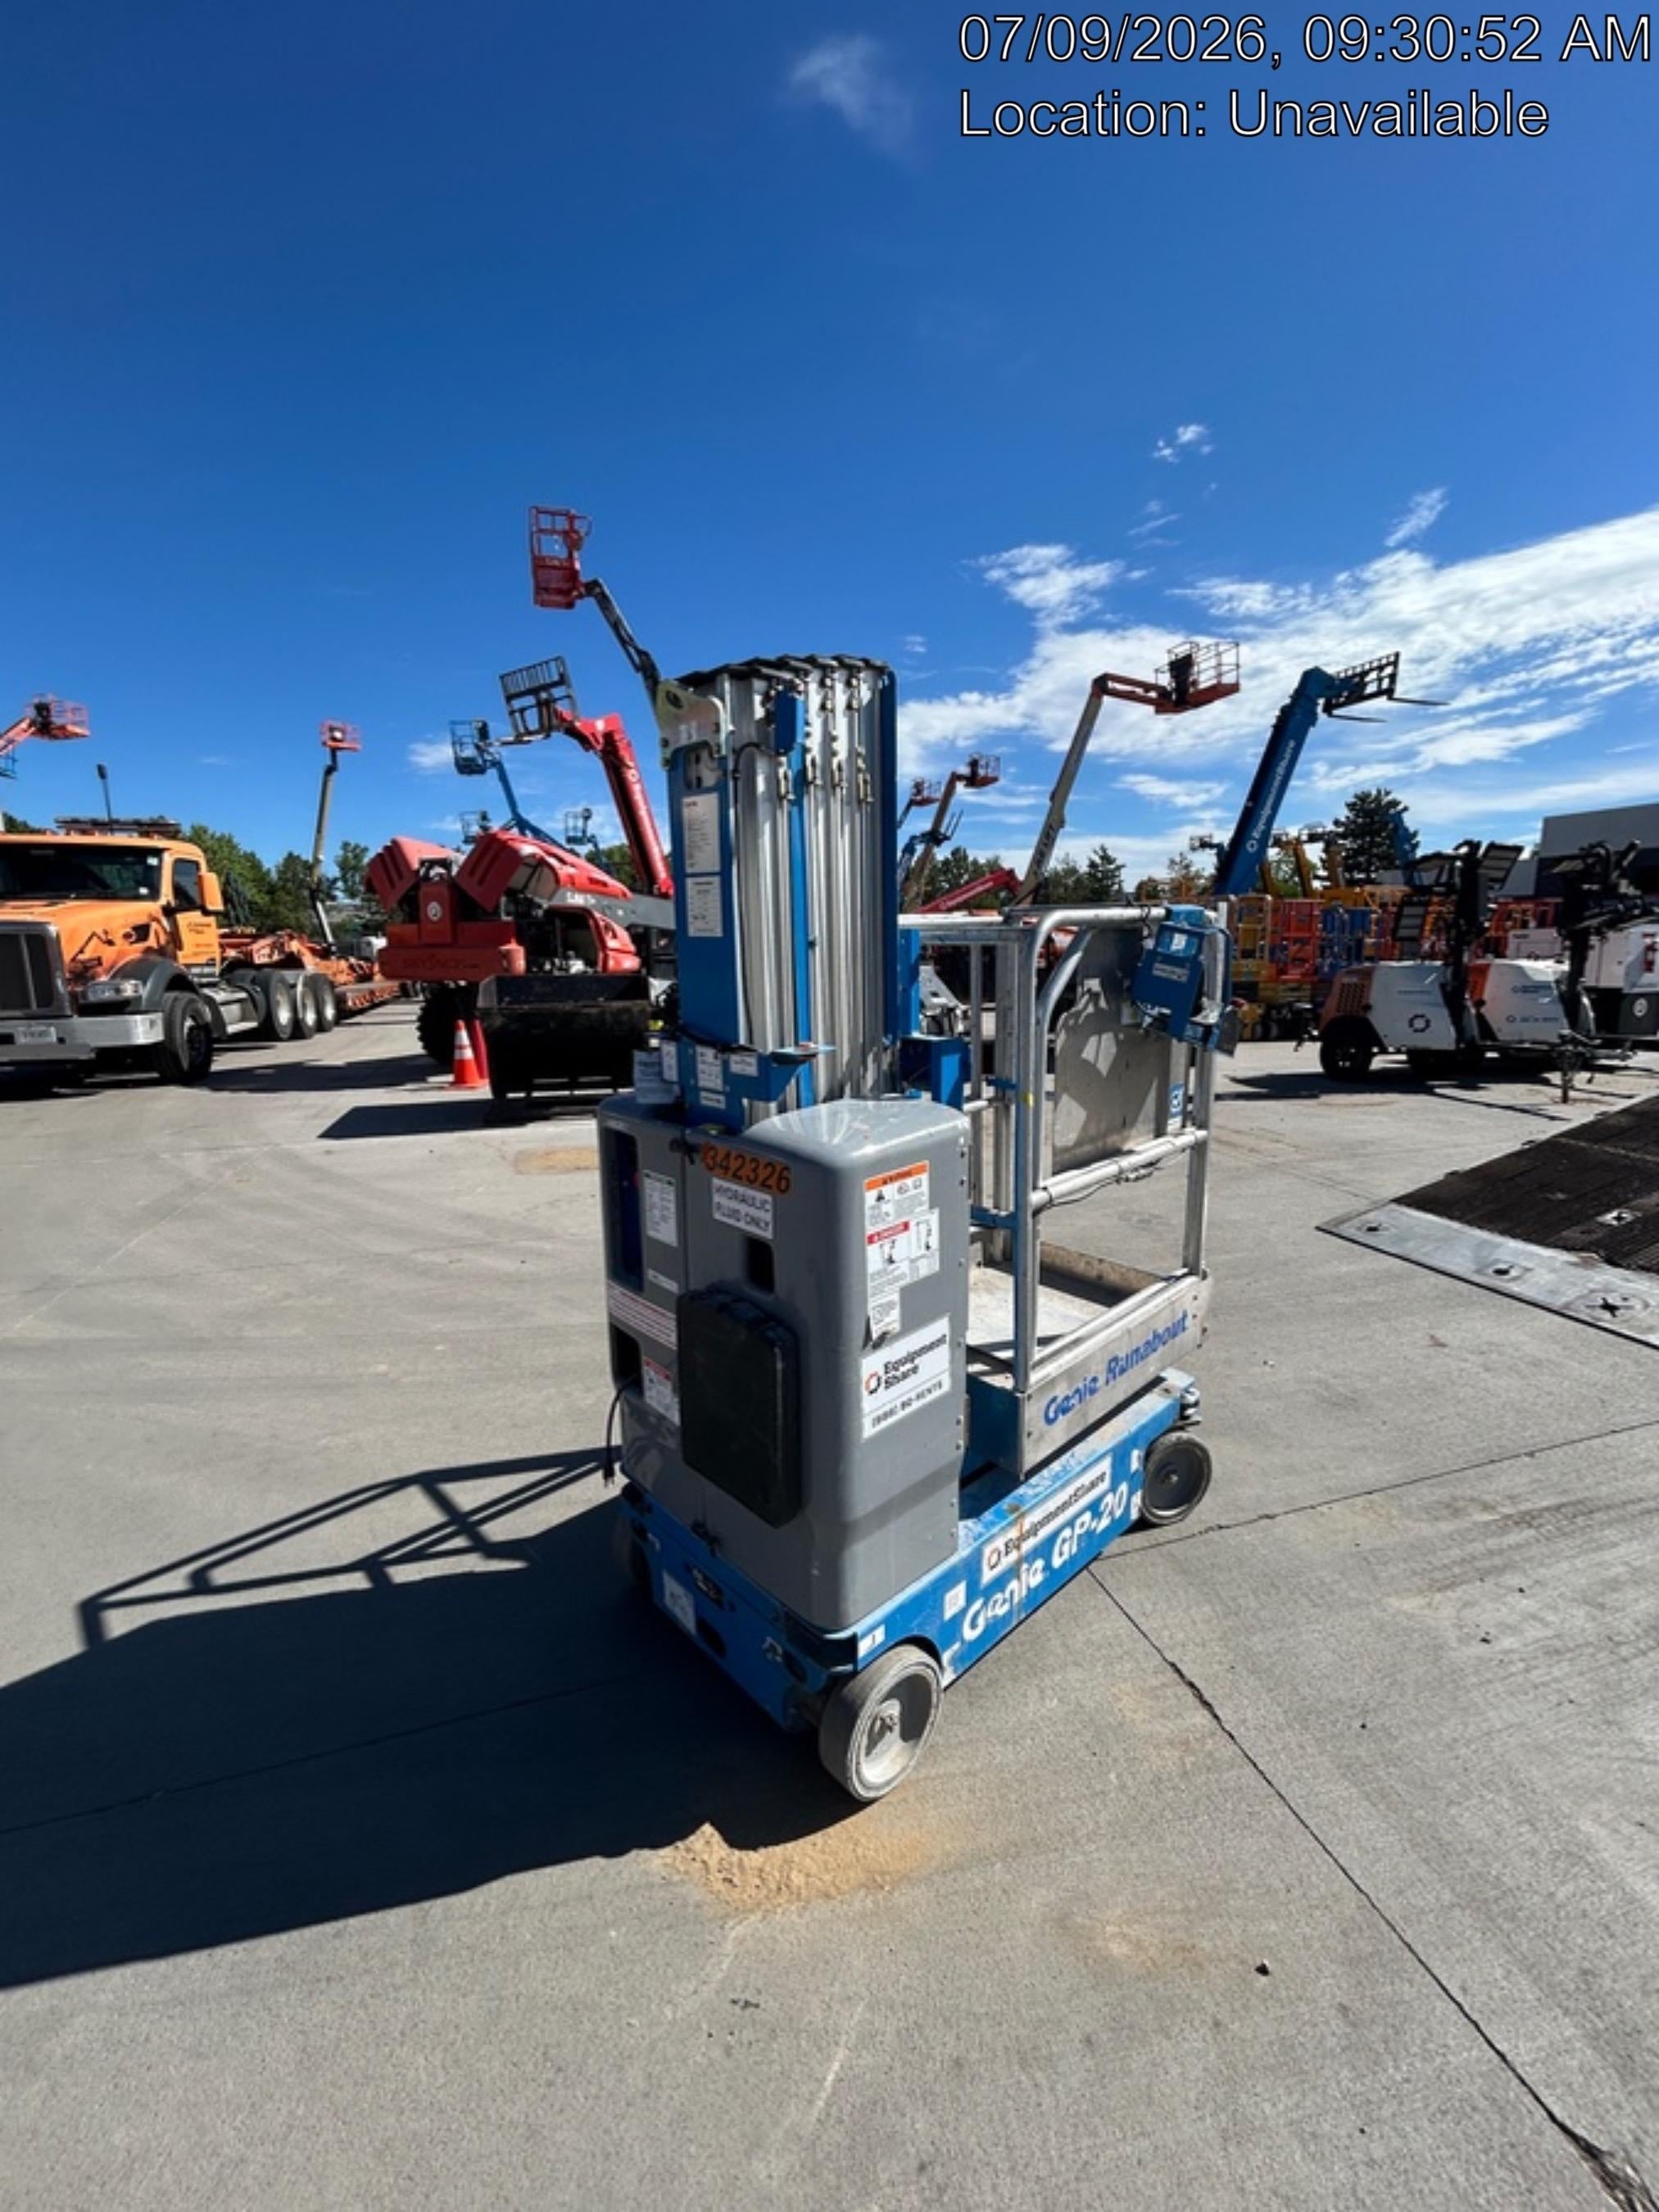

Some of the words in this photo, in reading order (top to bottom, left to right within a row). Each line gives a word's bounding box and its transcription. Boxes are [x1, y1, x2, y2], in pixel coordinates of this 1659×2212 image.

[706, 1145, 791, 1194] 342326
[714, 1184, 771, 1213] HYDRAULIC
[715, 1201, 741, 1222] FLUID
[884, 1334, 947, 1374] Equipment
[1044, 1376, 1099, 1426] Genie
[1105, 1310, 1188, 1385] Runabout
[884, 1364, 918, 1390] Share
[1004, 1472, 1107, 1555] EquipmentShare
[963, 1557, 1045, 1641] Genie
[1051, 1481, 1129, 1570] GP-20
